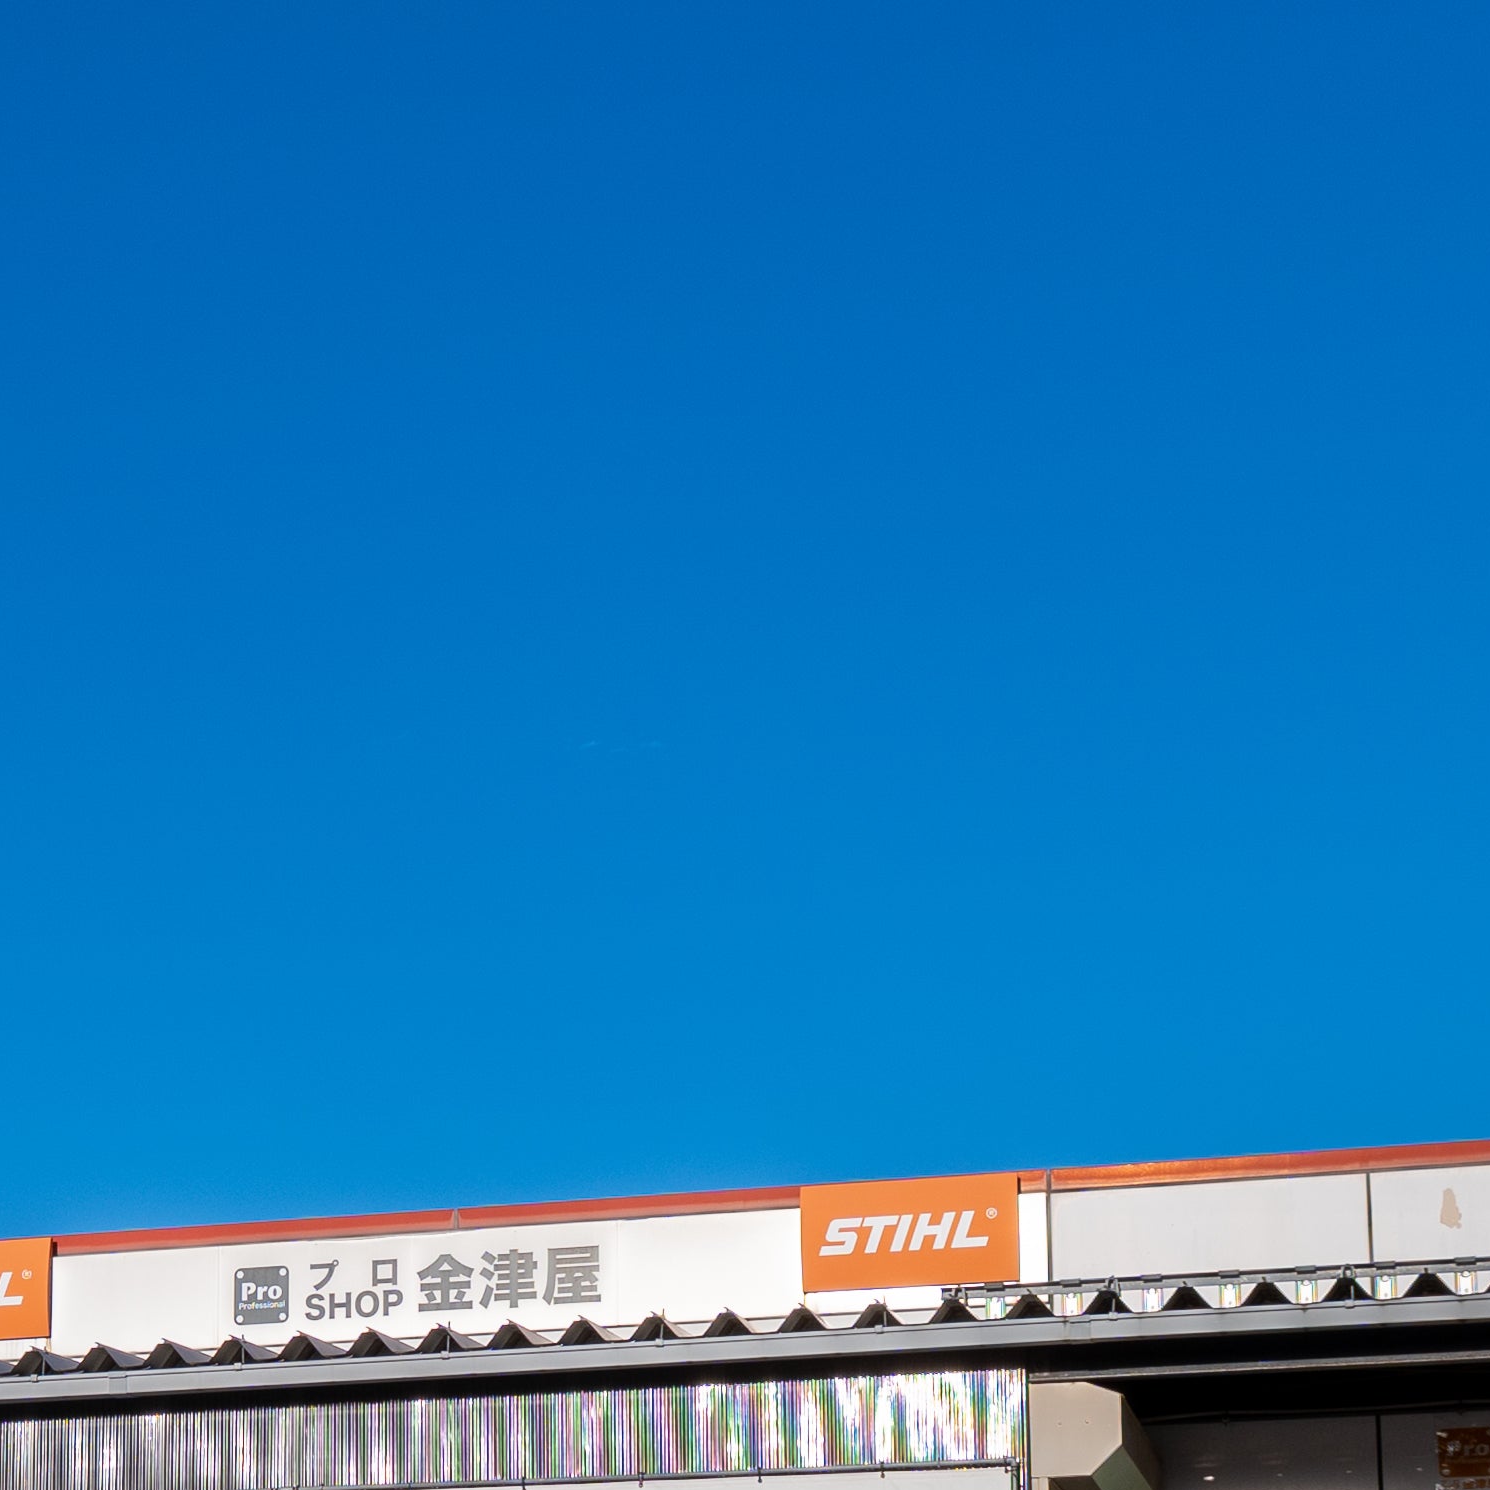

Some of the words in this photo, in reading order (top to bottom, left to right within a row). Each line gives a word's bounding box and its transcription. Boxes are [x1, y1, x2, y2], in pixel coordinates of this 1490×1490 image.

[818, 1210, 989, 1257] STIHL
[309, 1258, 398, 1291] プロ
[416, 1245, 602, 1313] 金津屋
[238, 1300, 286, 1310] Professional
[241, 1282, 283, 1301] Pro
[304, 1288, 404, 1321] SHOP
